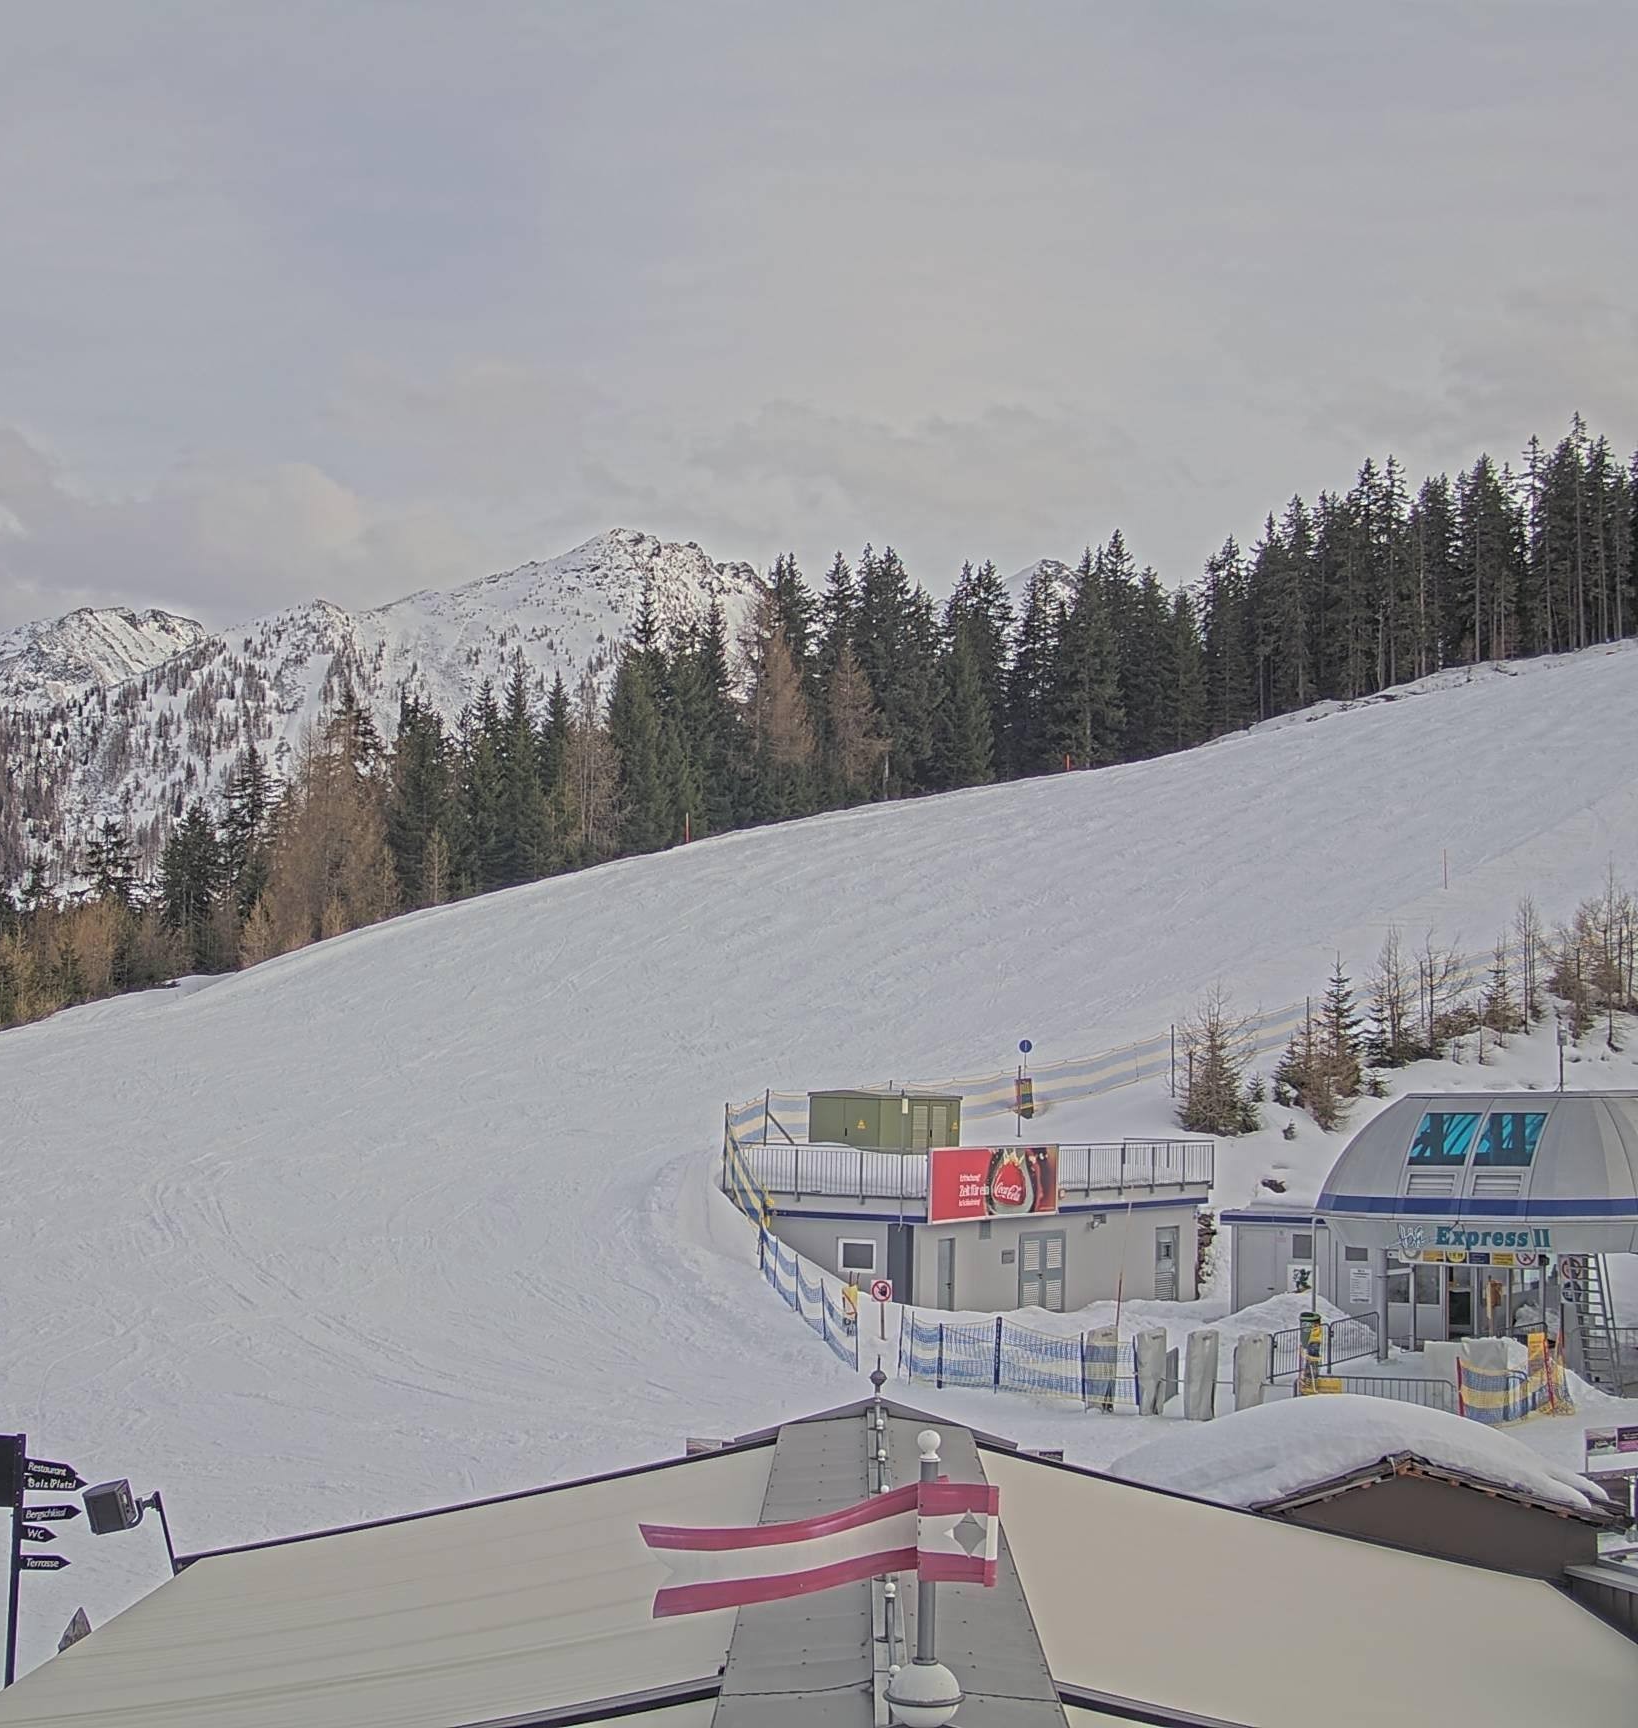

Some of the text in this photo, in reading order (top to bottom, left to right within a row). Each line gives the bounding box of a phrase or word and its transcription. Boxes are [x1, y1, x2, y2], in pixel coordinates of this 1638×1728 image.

[1436, 1226, 1529, 1250] Express
[28, 1462, 67, 1476] Restaurant
[27, 1528, 45, 1539] WC
[26, 1558, 60, 1568] Terrasse
